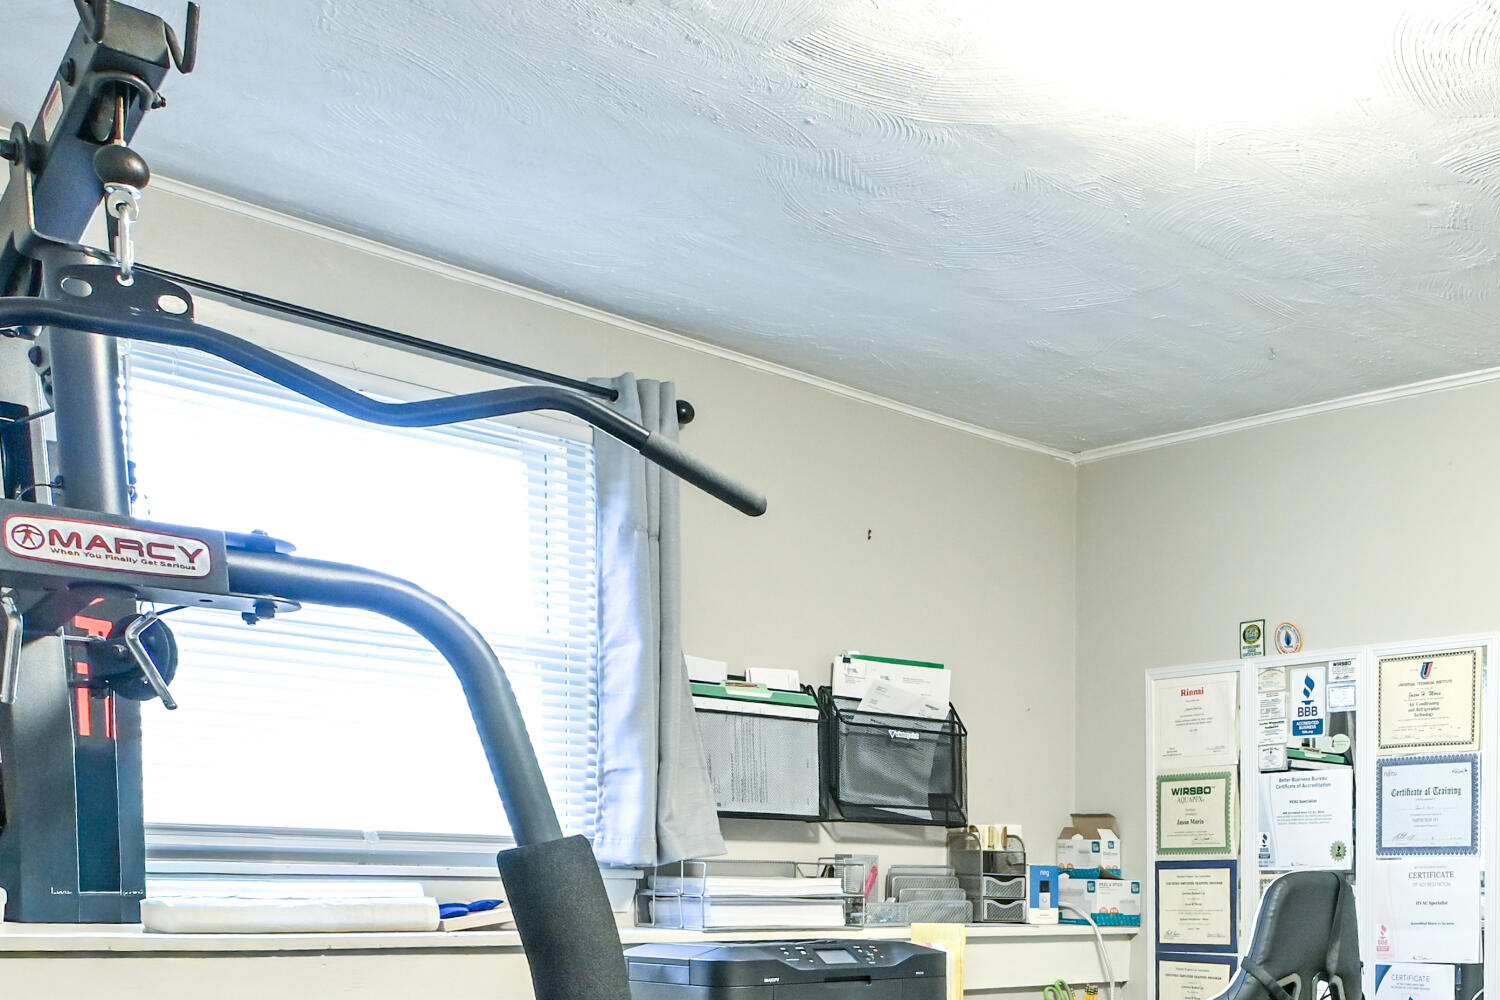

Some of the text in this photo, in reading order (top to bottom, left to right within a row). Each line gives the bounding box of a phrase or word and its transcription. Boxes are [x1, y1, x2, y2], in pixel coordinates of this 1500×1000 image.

[48, 528, 204, 564] MARCY
[50, 547, 80, 556] When
[105, 554, 138, 564] Finally
[141, 558, 158, 566] Get
[160, 561, 196, 571] Serious
[1180, 686, 1204, 696] Rinnai
[1298, 706, 1318, 717] BBB
[1171, 786, 1212, 796] WIRSBO
[1391, 786, 1462, 798] Certificate of Training
[1408, 871, 1454, 880] CERTIFICATE
[1392, 974, 1430, 982] CERTIFICATE
